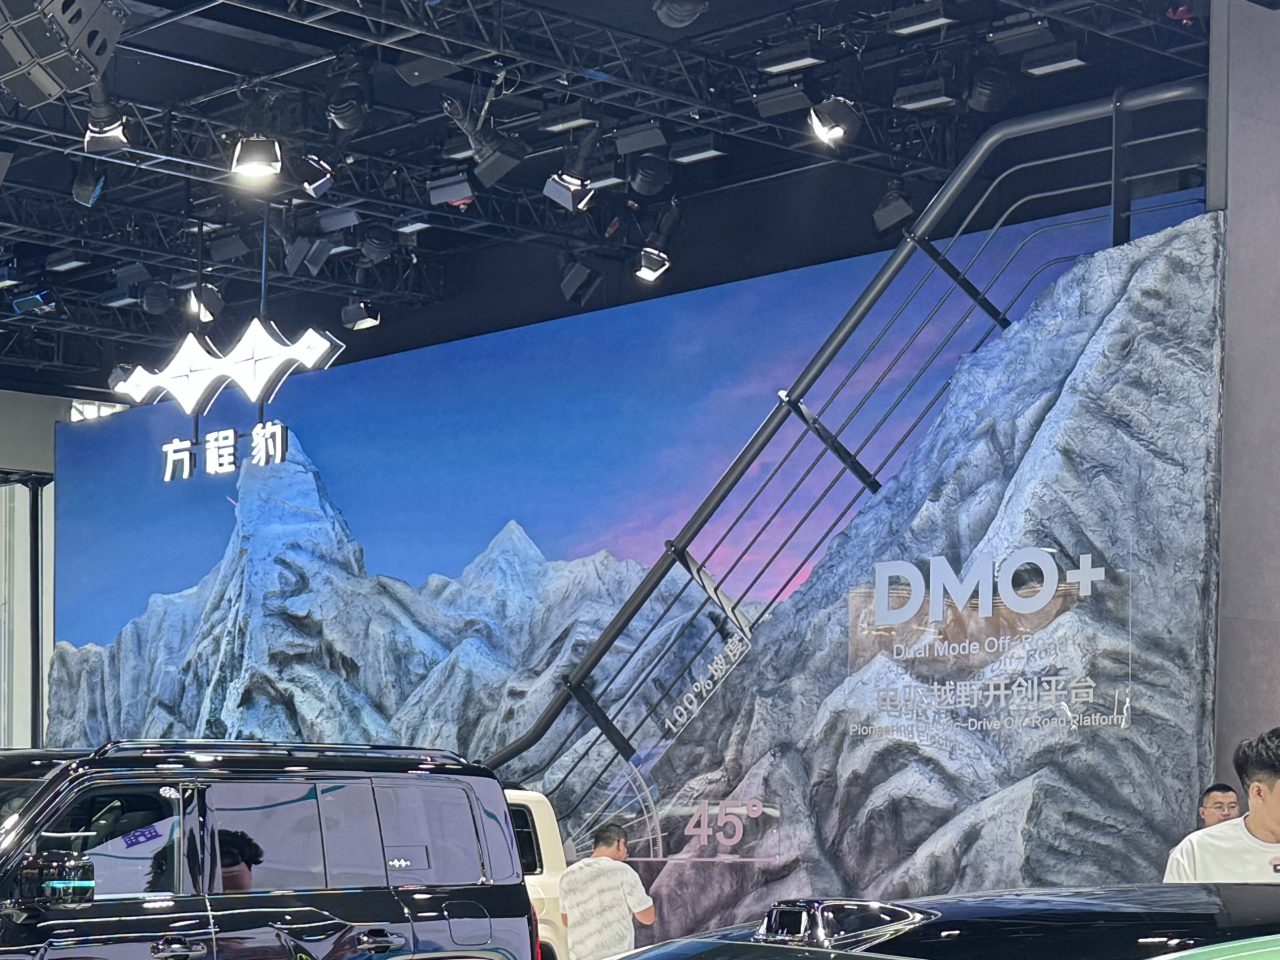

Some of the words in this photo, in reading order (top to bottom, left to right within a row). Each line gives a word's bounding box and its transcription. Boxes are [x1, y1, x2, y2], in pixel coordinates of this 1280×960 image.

[162, 421, 283, 482] 方程豹
[874, 546, 1106, 627] DMO+
[893, 643, 929, 660] Dual
[934, 638, 980, 656] Mode
[684, 799, 764, 846] 45°
